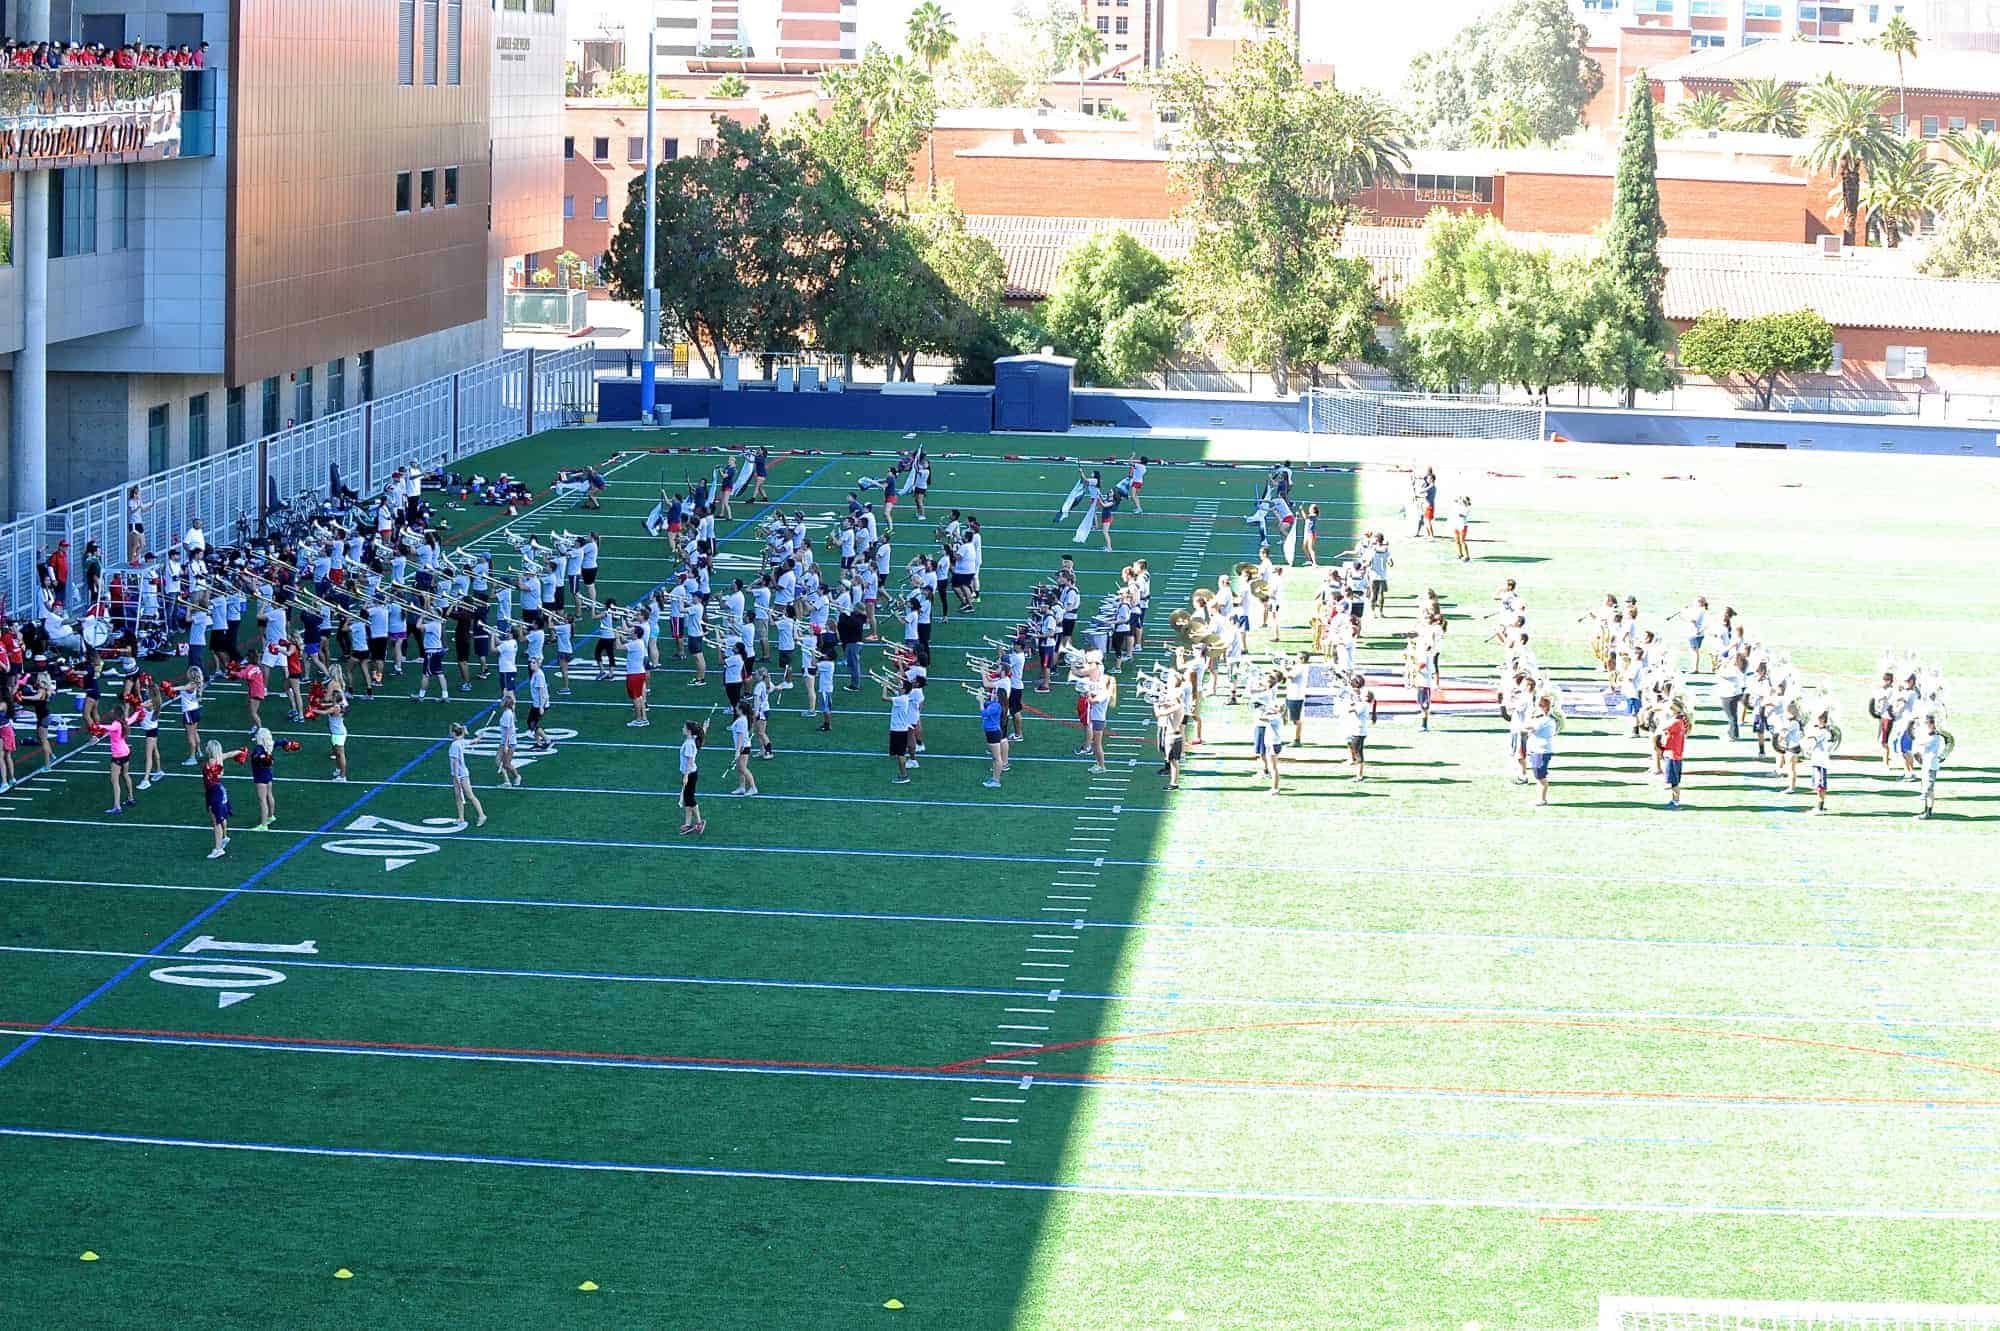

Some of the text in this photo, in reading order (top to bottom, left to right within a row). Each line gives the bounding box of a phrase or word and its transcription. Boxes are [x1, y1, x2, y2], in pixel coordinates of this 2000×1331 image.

[18, 126, 90, 159] FOOTBALL
[321, 815, 468, 856] 20
[149, 935, 318, 988] 10
